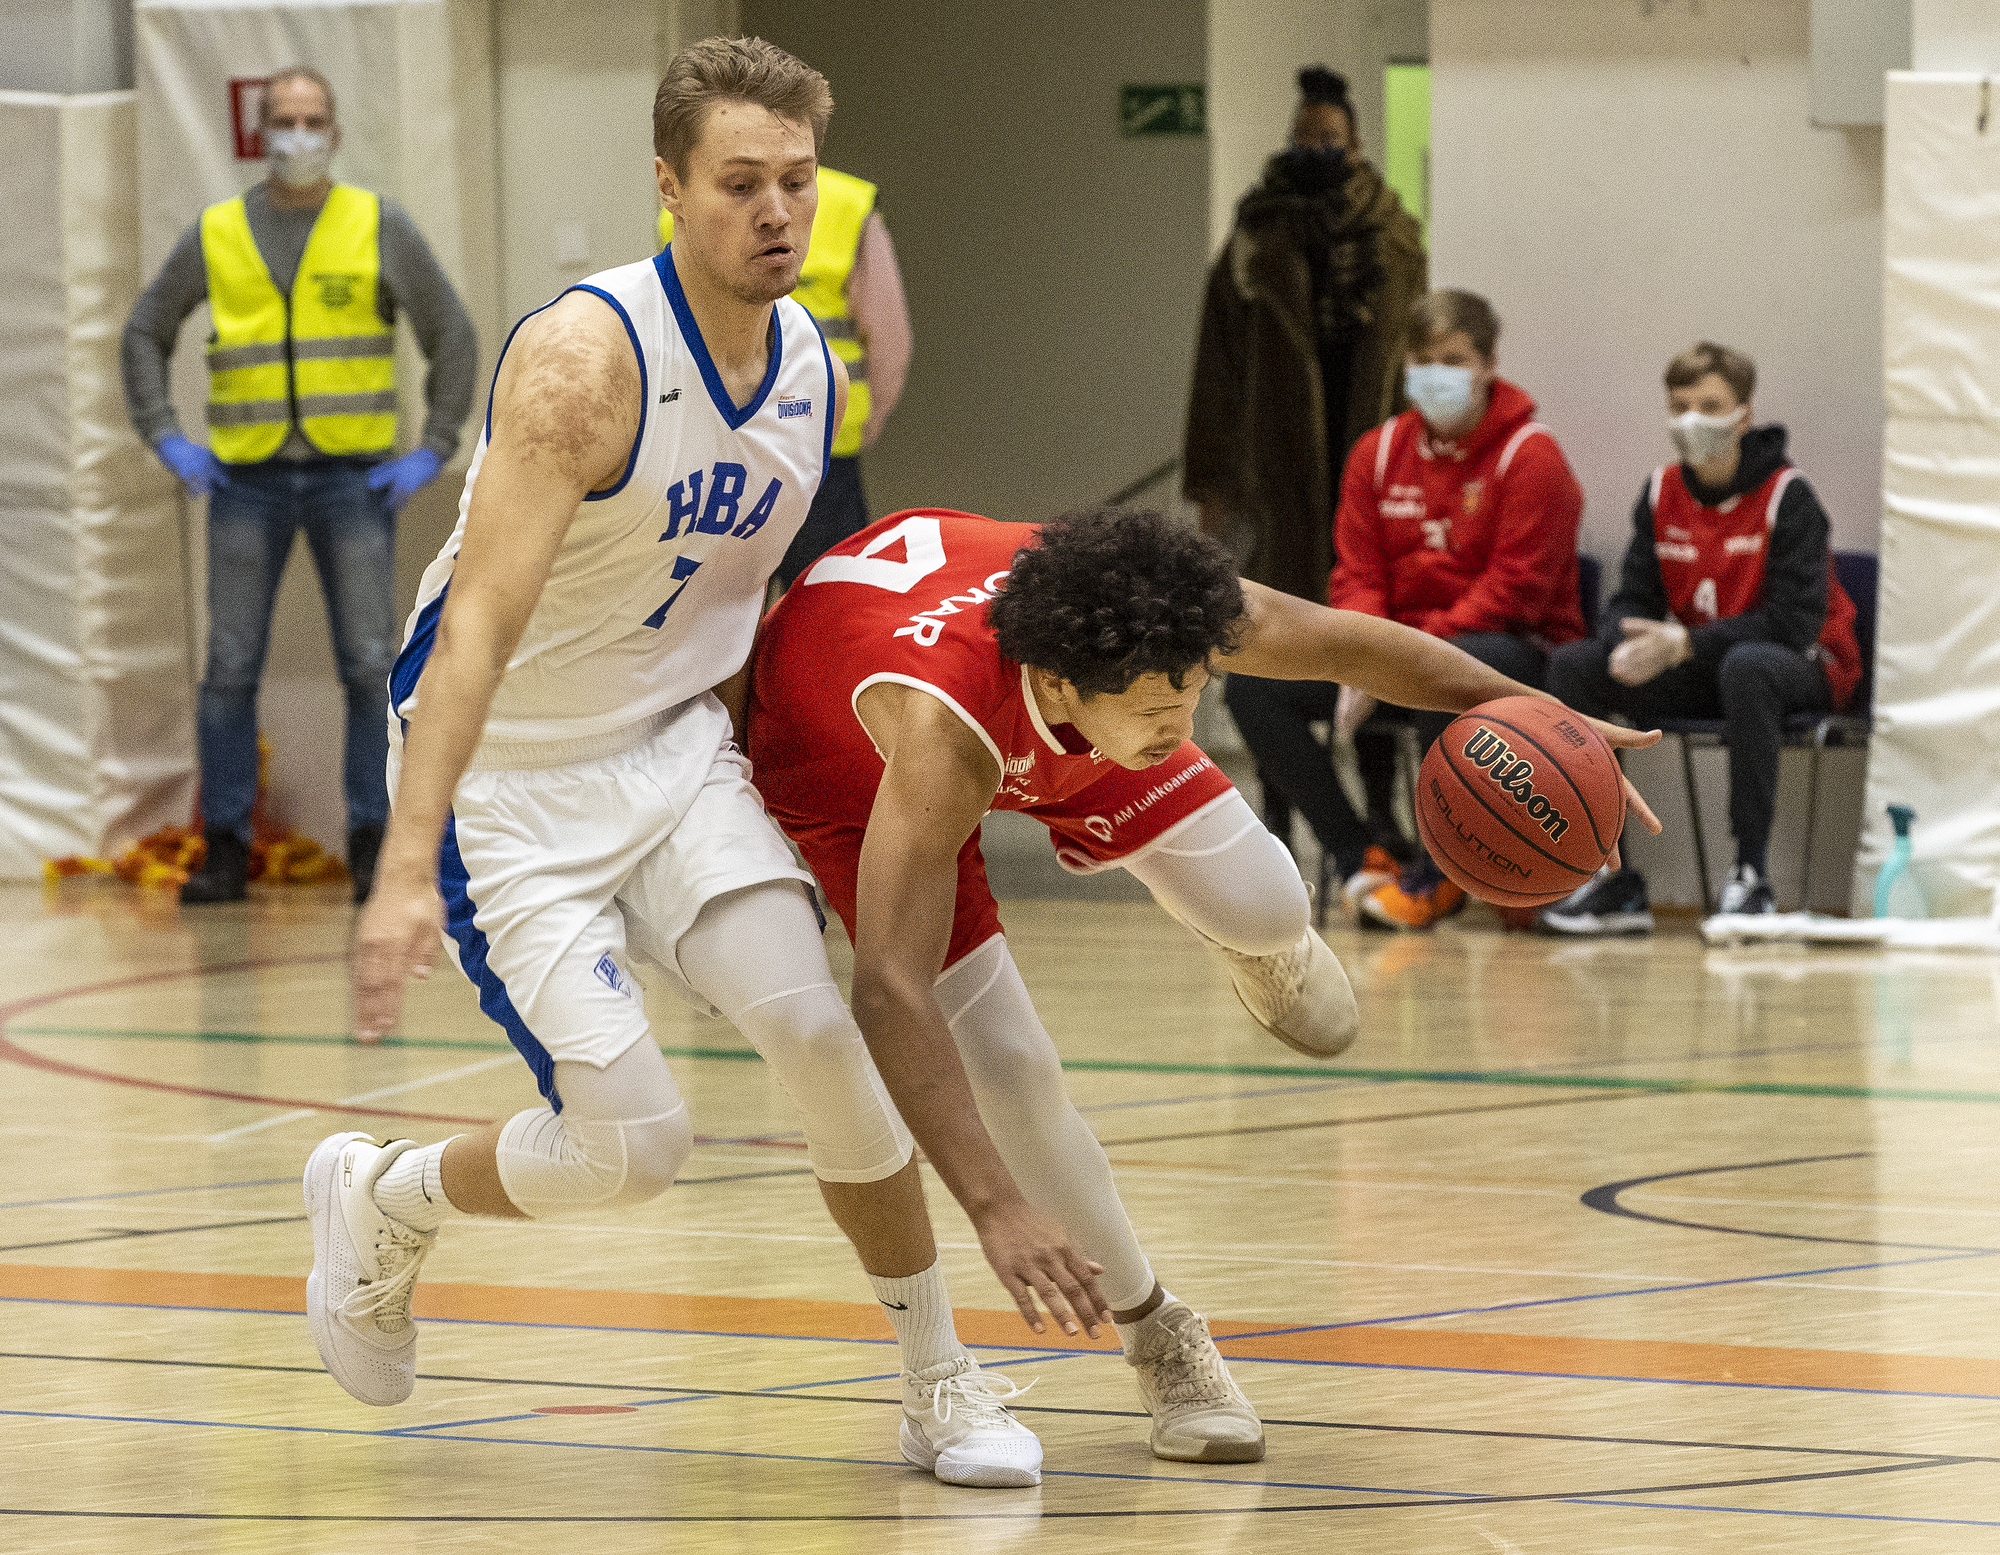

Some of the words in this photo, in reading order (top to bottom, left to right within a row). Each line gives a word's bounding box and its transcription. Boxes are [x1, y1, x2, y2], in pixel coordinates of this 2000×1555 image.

[658, 462, 783, 542] HBA
[642, 555, 703, 629] 7
[1430, 778, 1532, 878] SOLUTION
[1461, 725, 1570, 844] Wilson
